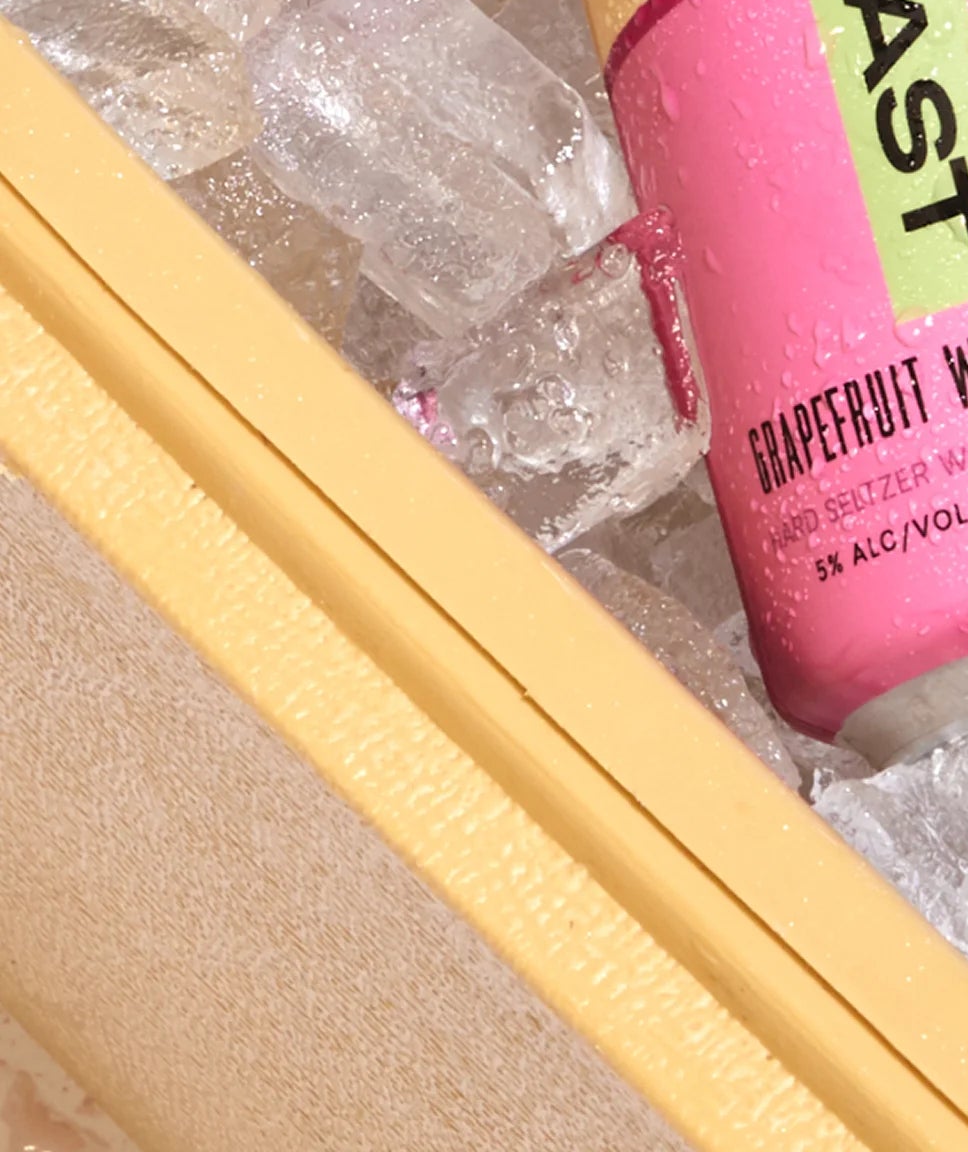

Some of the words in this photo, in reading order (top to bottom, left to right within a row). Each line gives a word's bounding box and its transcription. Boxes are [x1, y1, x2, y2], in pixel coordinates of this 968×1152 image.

[748, 356, 929, 495] GRAPEFRUIT
[769, 508, 820, 550] HARD
[823, 460, 930, 524] SELTZER
[815, 550, 844, 581] 5%
[853, 503, 968, 566] ALC/VOL
